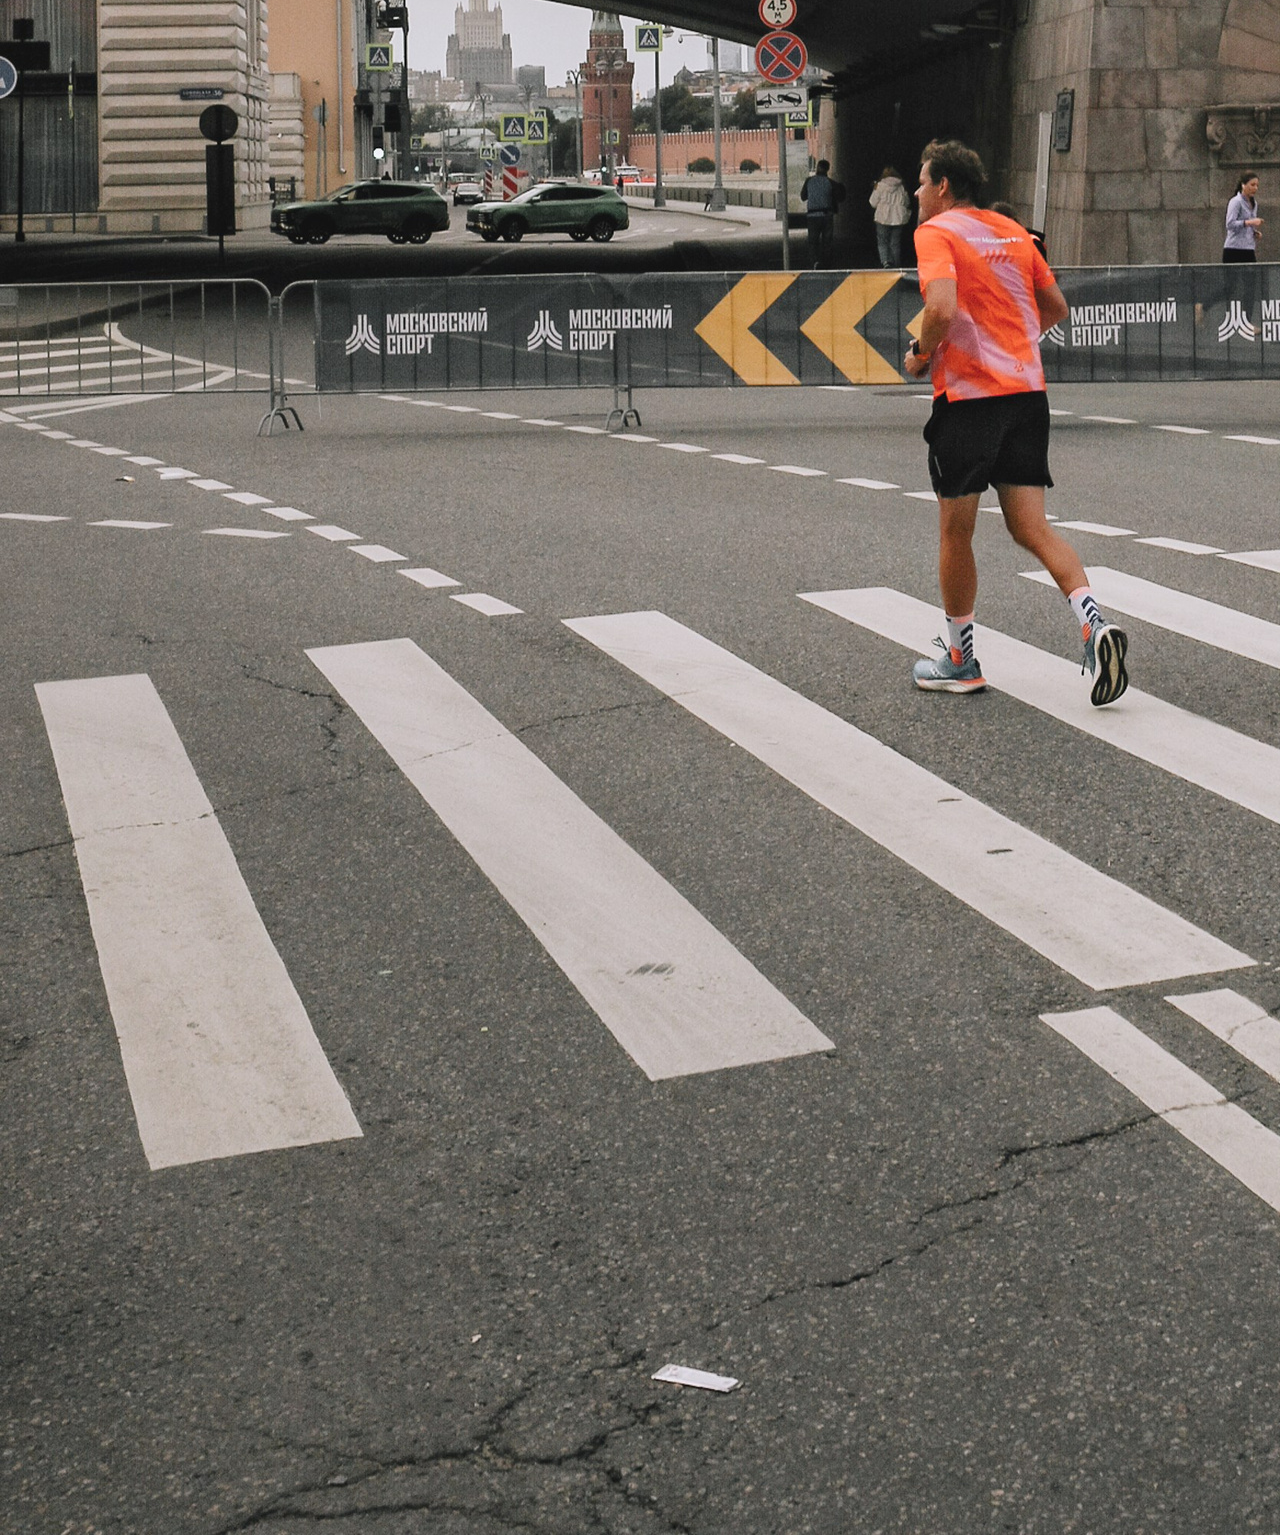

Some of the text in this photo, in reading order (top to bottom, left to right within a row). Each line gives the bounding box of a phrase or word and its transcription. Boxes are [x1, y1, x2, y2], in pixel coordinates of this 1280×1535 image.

[386, 308, 488, 334] МОСКОВСКИЙ
[570, 304, 673, 330] МОСКОВСКИЙ
[1070, 297, 1177, 326] МОСКОВСКИЙ
[386, 334, 434, 355] СПОРТ
[570, 330, 616, 350] СПОРТ
[1072, 325, 1122, 346] СПОРТ
